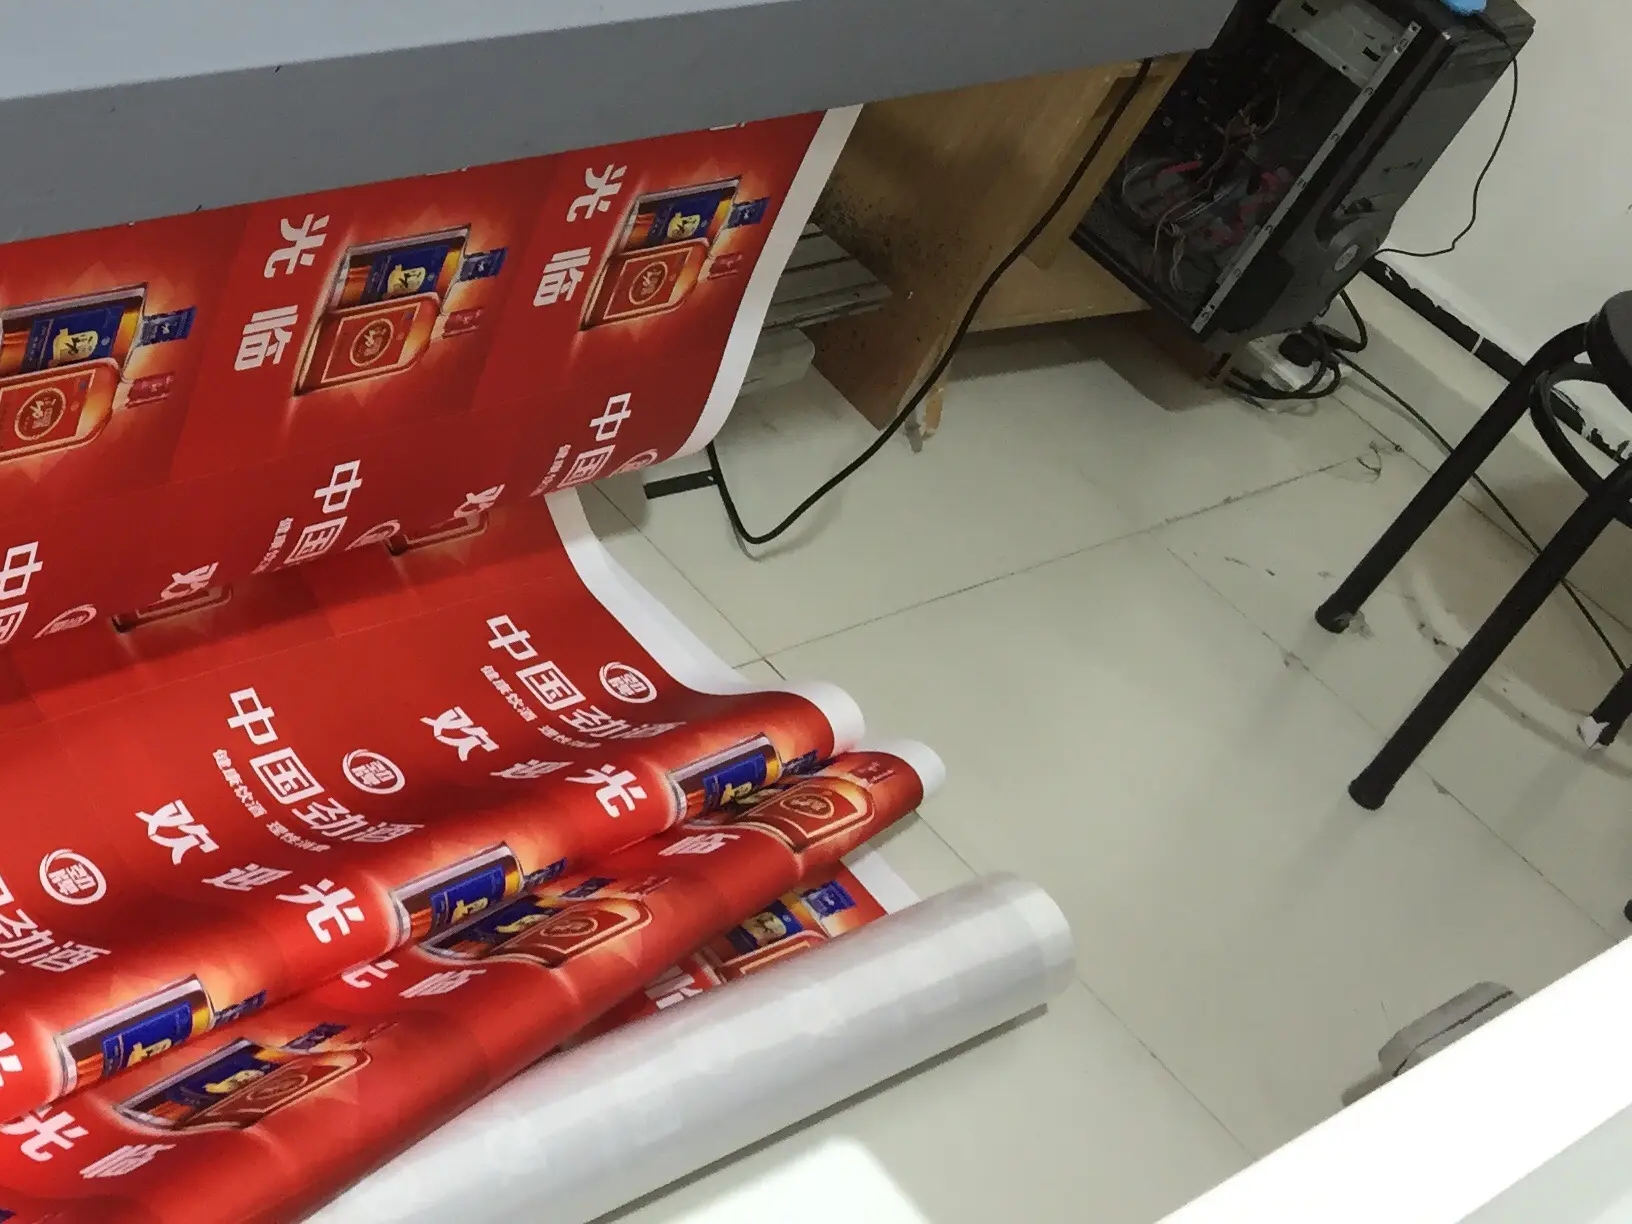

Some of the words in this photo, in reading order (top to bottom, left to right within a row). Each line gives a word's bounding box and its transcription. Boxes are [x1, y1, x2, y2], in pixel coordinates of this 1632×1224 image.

[235, 214, 329, 371] 光临
[534, 165, 626, 306] 光临
[285, 460, 362, 563] 中国
[564, 393, 631, 491] 中国
[226, 688, 424, 843] 中国劲酒
